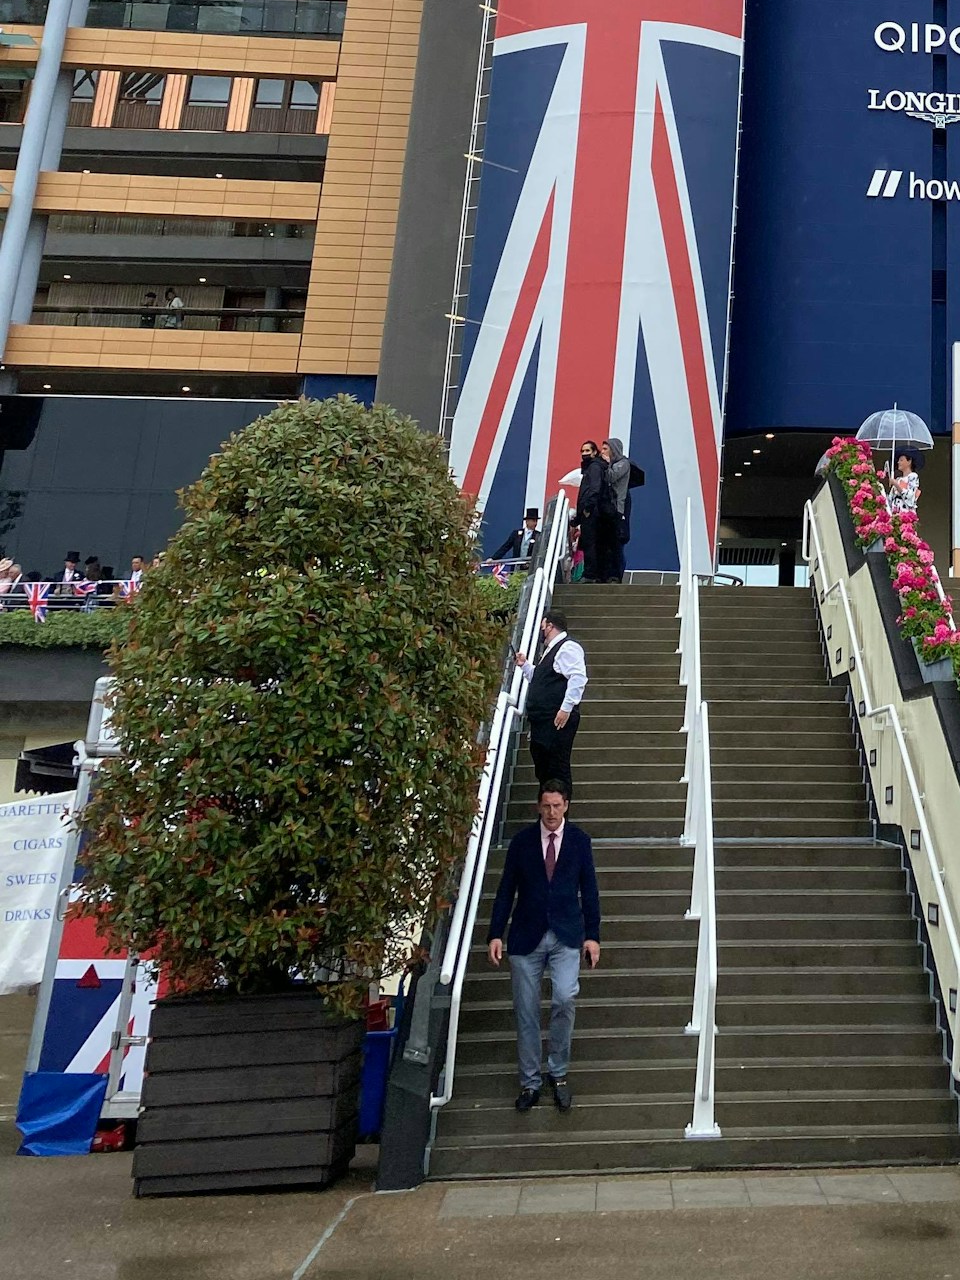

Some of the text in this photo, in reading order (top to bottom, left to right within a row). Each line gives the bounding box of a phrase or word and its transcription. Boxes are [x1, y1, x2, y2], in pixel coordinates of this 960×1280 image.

[13, 838, 63, 851] CIGARS
[6, 873, 57, 887] SWEETS
[5, 908, 51, 922] DRINKS
